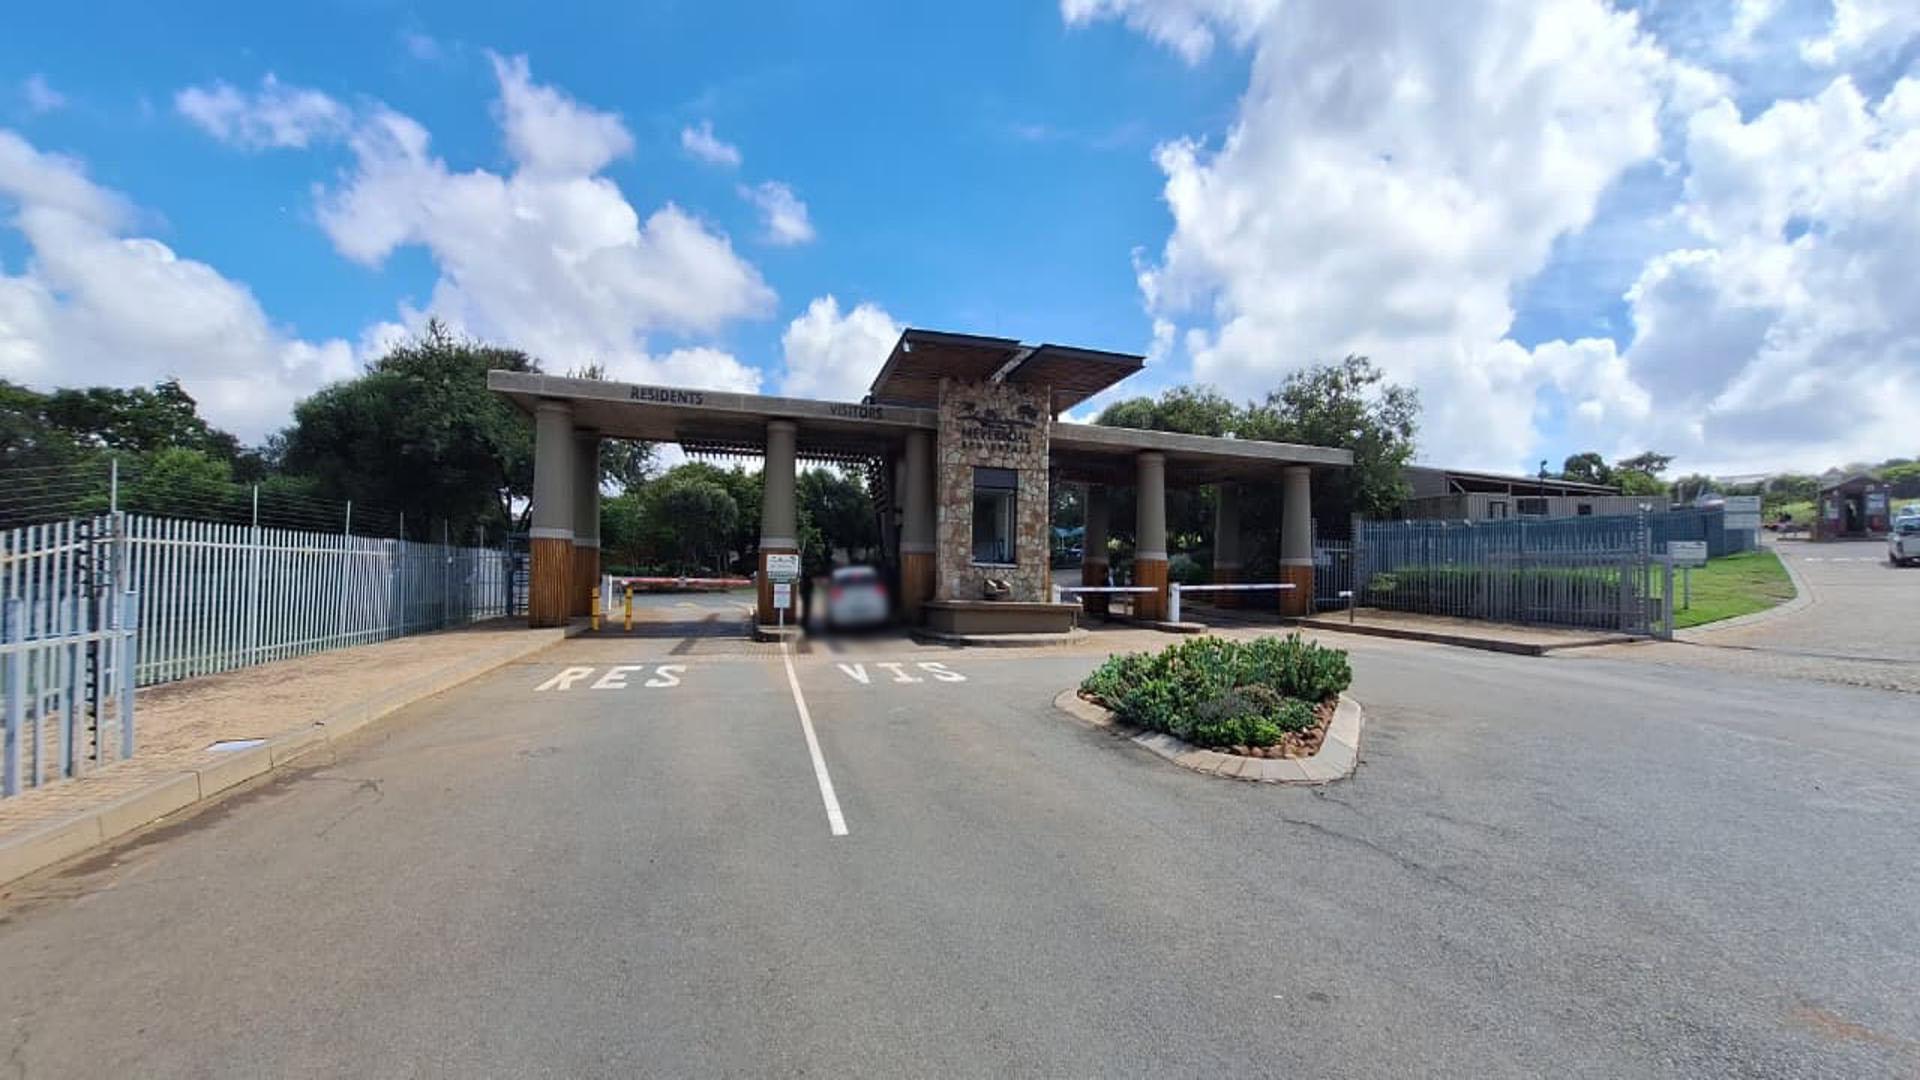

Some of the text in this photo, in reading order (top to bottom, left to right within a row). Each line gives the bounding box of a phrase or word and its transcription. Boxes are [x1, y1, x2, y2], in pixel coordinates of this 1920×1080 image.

[630, 385, 704, 405] RESIDENTS
[829, 403, 883, 419] VISITORS
[533, 664, 687, 692] RES
[836, 662, 967, 684] VIS
